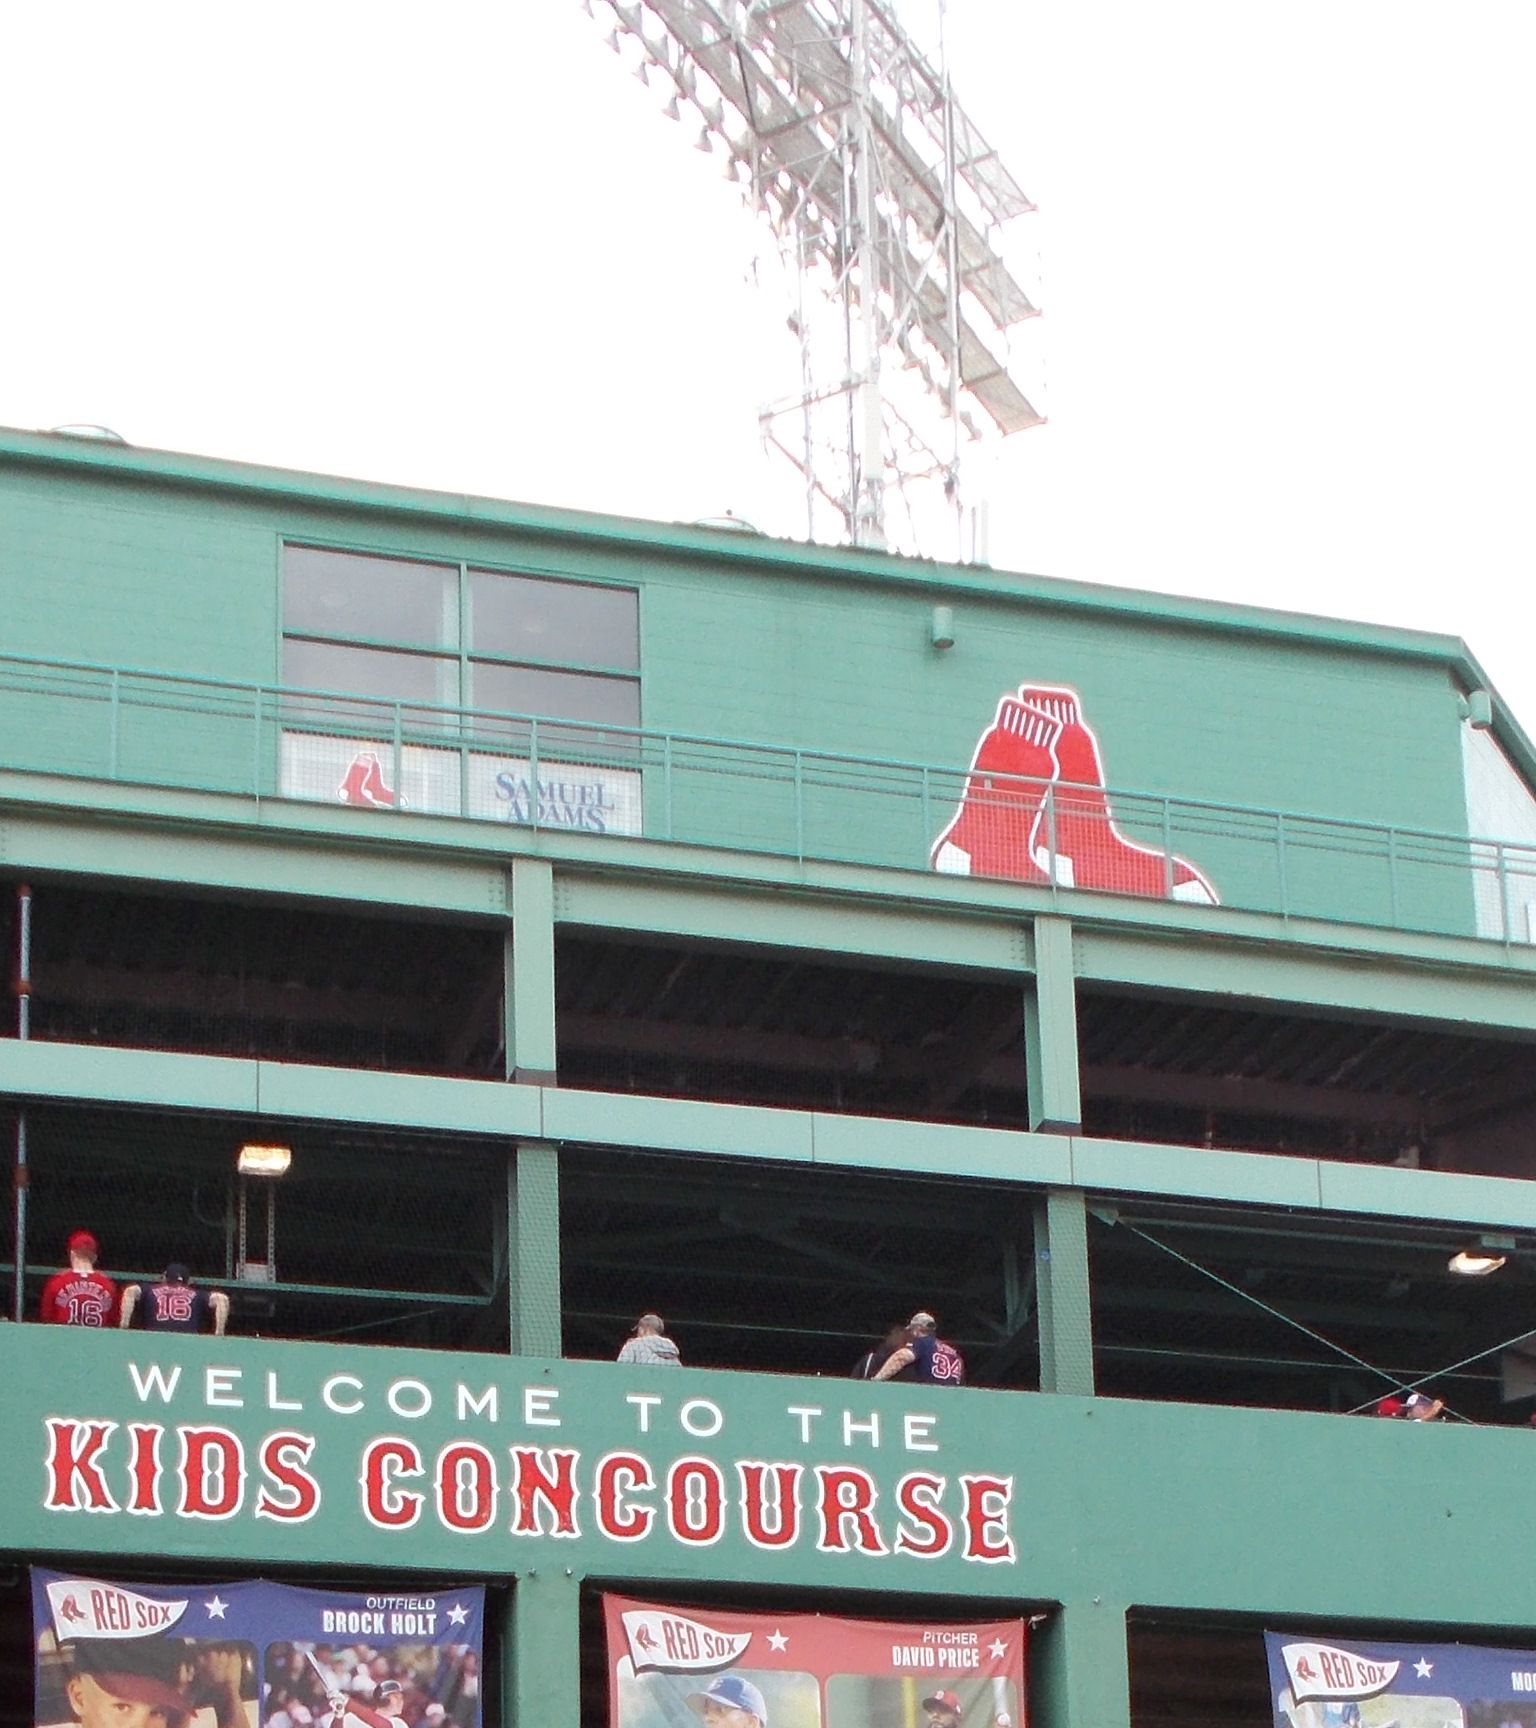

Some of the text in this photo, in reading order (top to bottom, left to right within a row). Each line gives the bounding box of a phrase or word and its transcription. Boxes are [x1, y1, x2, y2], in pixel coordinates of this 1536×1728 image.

[495, 773, 614, 811] SAMUEL
[506, 799, 606, 833] ADAMS
[68, 1298, 102, 1327] 16
[931, 1352, 963, 1385] 34
[128, 1362, 941, 1453] WELCOME TO THE
[44, 1416, 1018, 1566] KIDS CONCOURSE
[91, 1589, 172, 1631] RED SOX
[366, 1596, 436, 1612] OUTFIELD
[323, 1610, 437, 1636] BROCK HOLT
[660, 1619, 737, 1661] RED SOX
[923, 1631, 979, 1646] PITCHER
[892, 1645, 980, 1669] DAVID PRICE
[1318, 1652, 1387, 1689] RED SOX
